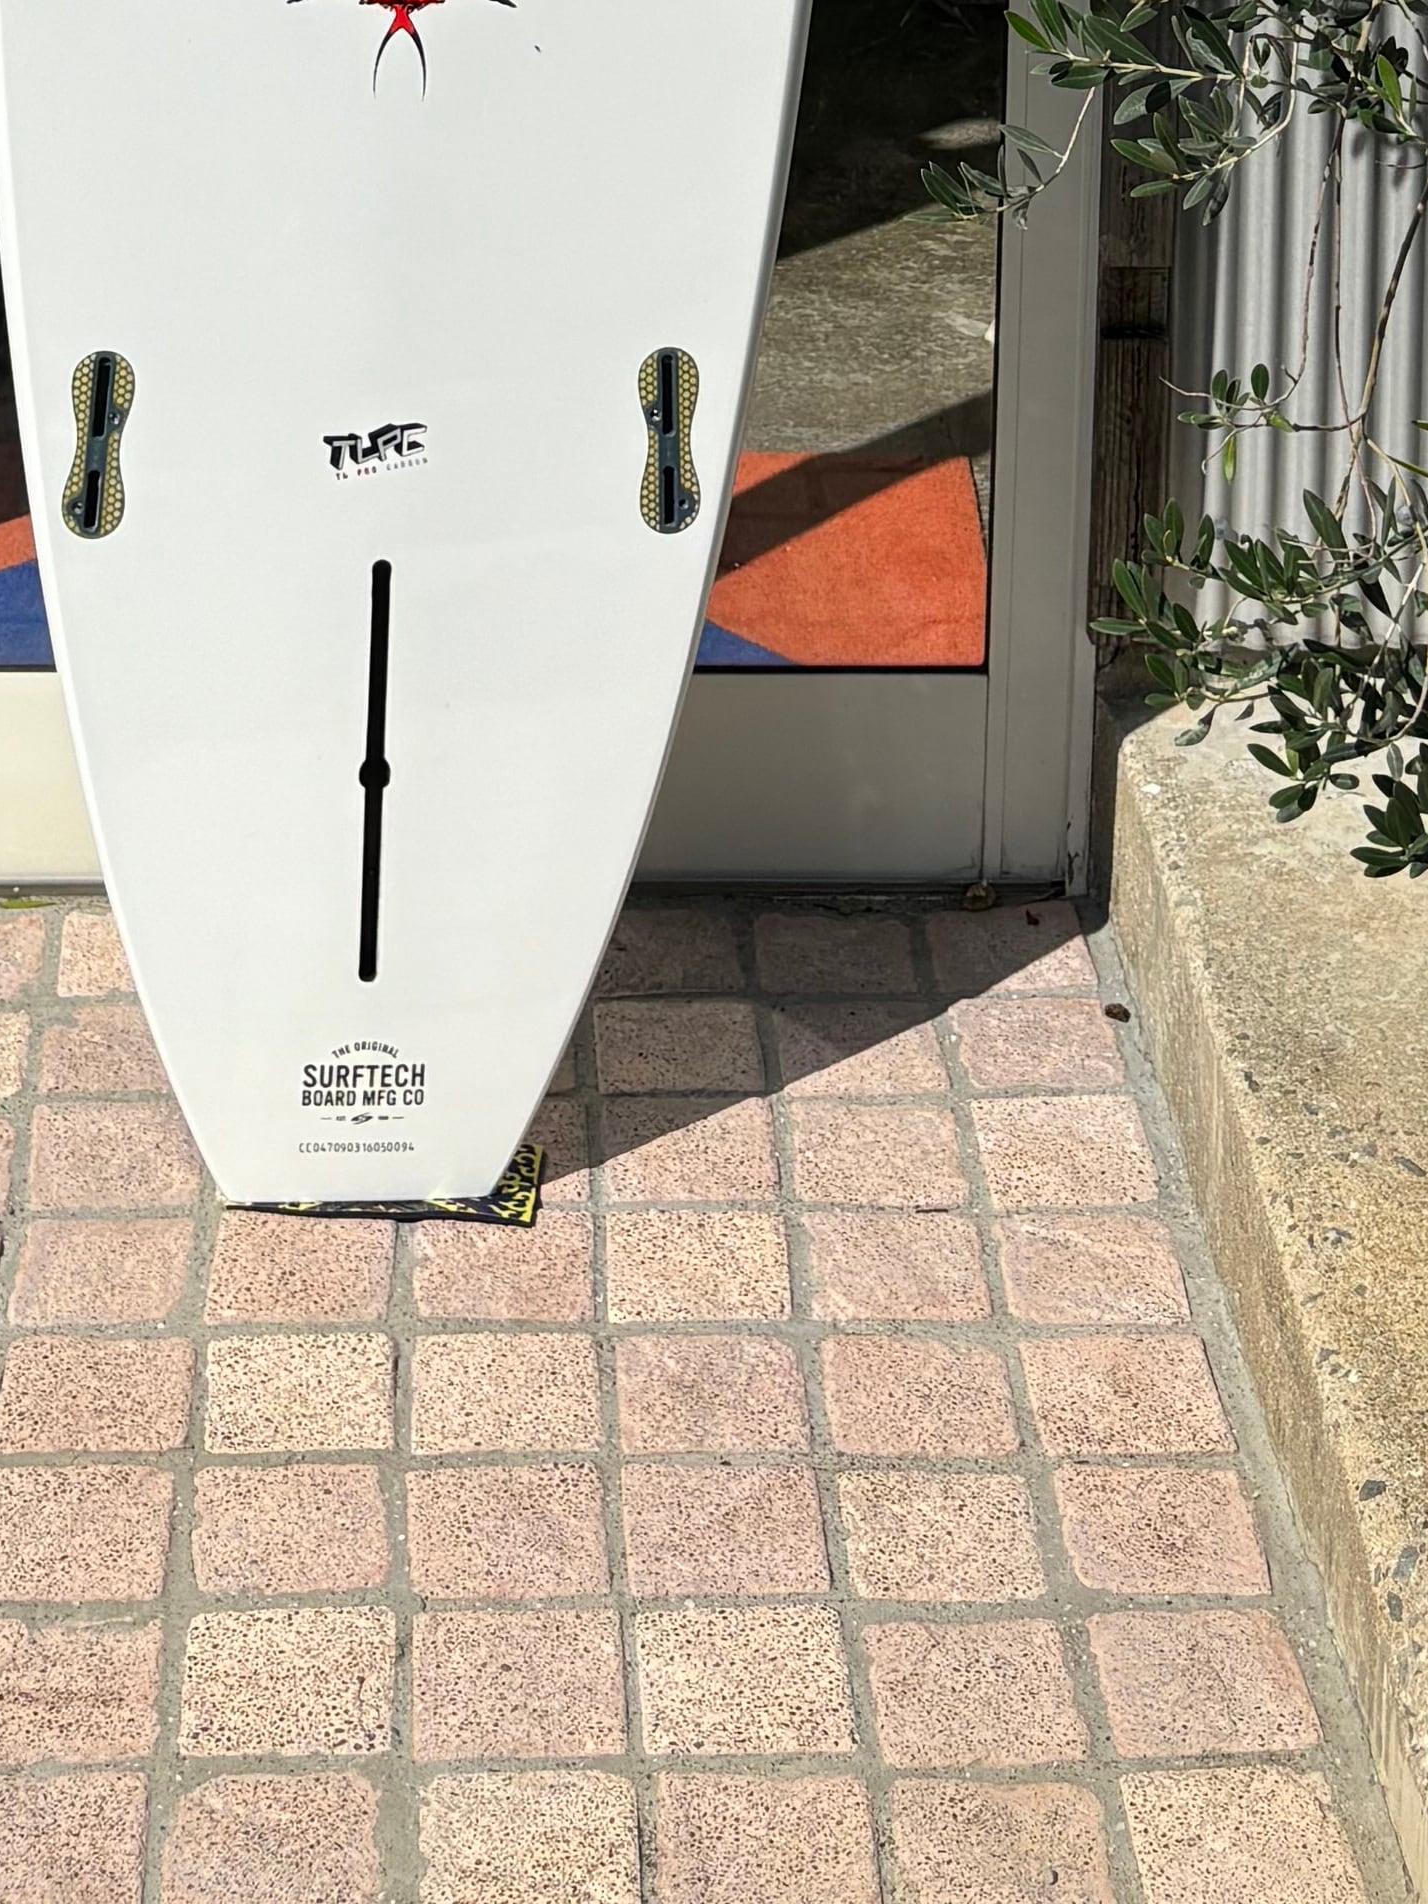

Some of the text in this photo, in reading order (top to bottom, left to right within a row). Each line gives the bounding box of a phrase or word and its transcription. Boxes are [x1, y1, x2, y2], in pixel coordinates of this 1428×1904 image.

[323, 422, 428, 471] TLPC
[332, 1040, 400, 1059] THE ORIGINAL
[302, 1063, 426, 1089] SURFTECH
[301, 1088, 425, 1107] BOARD MFG CO
